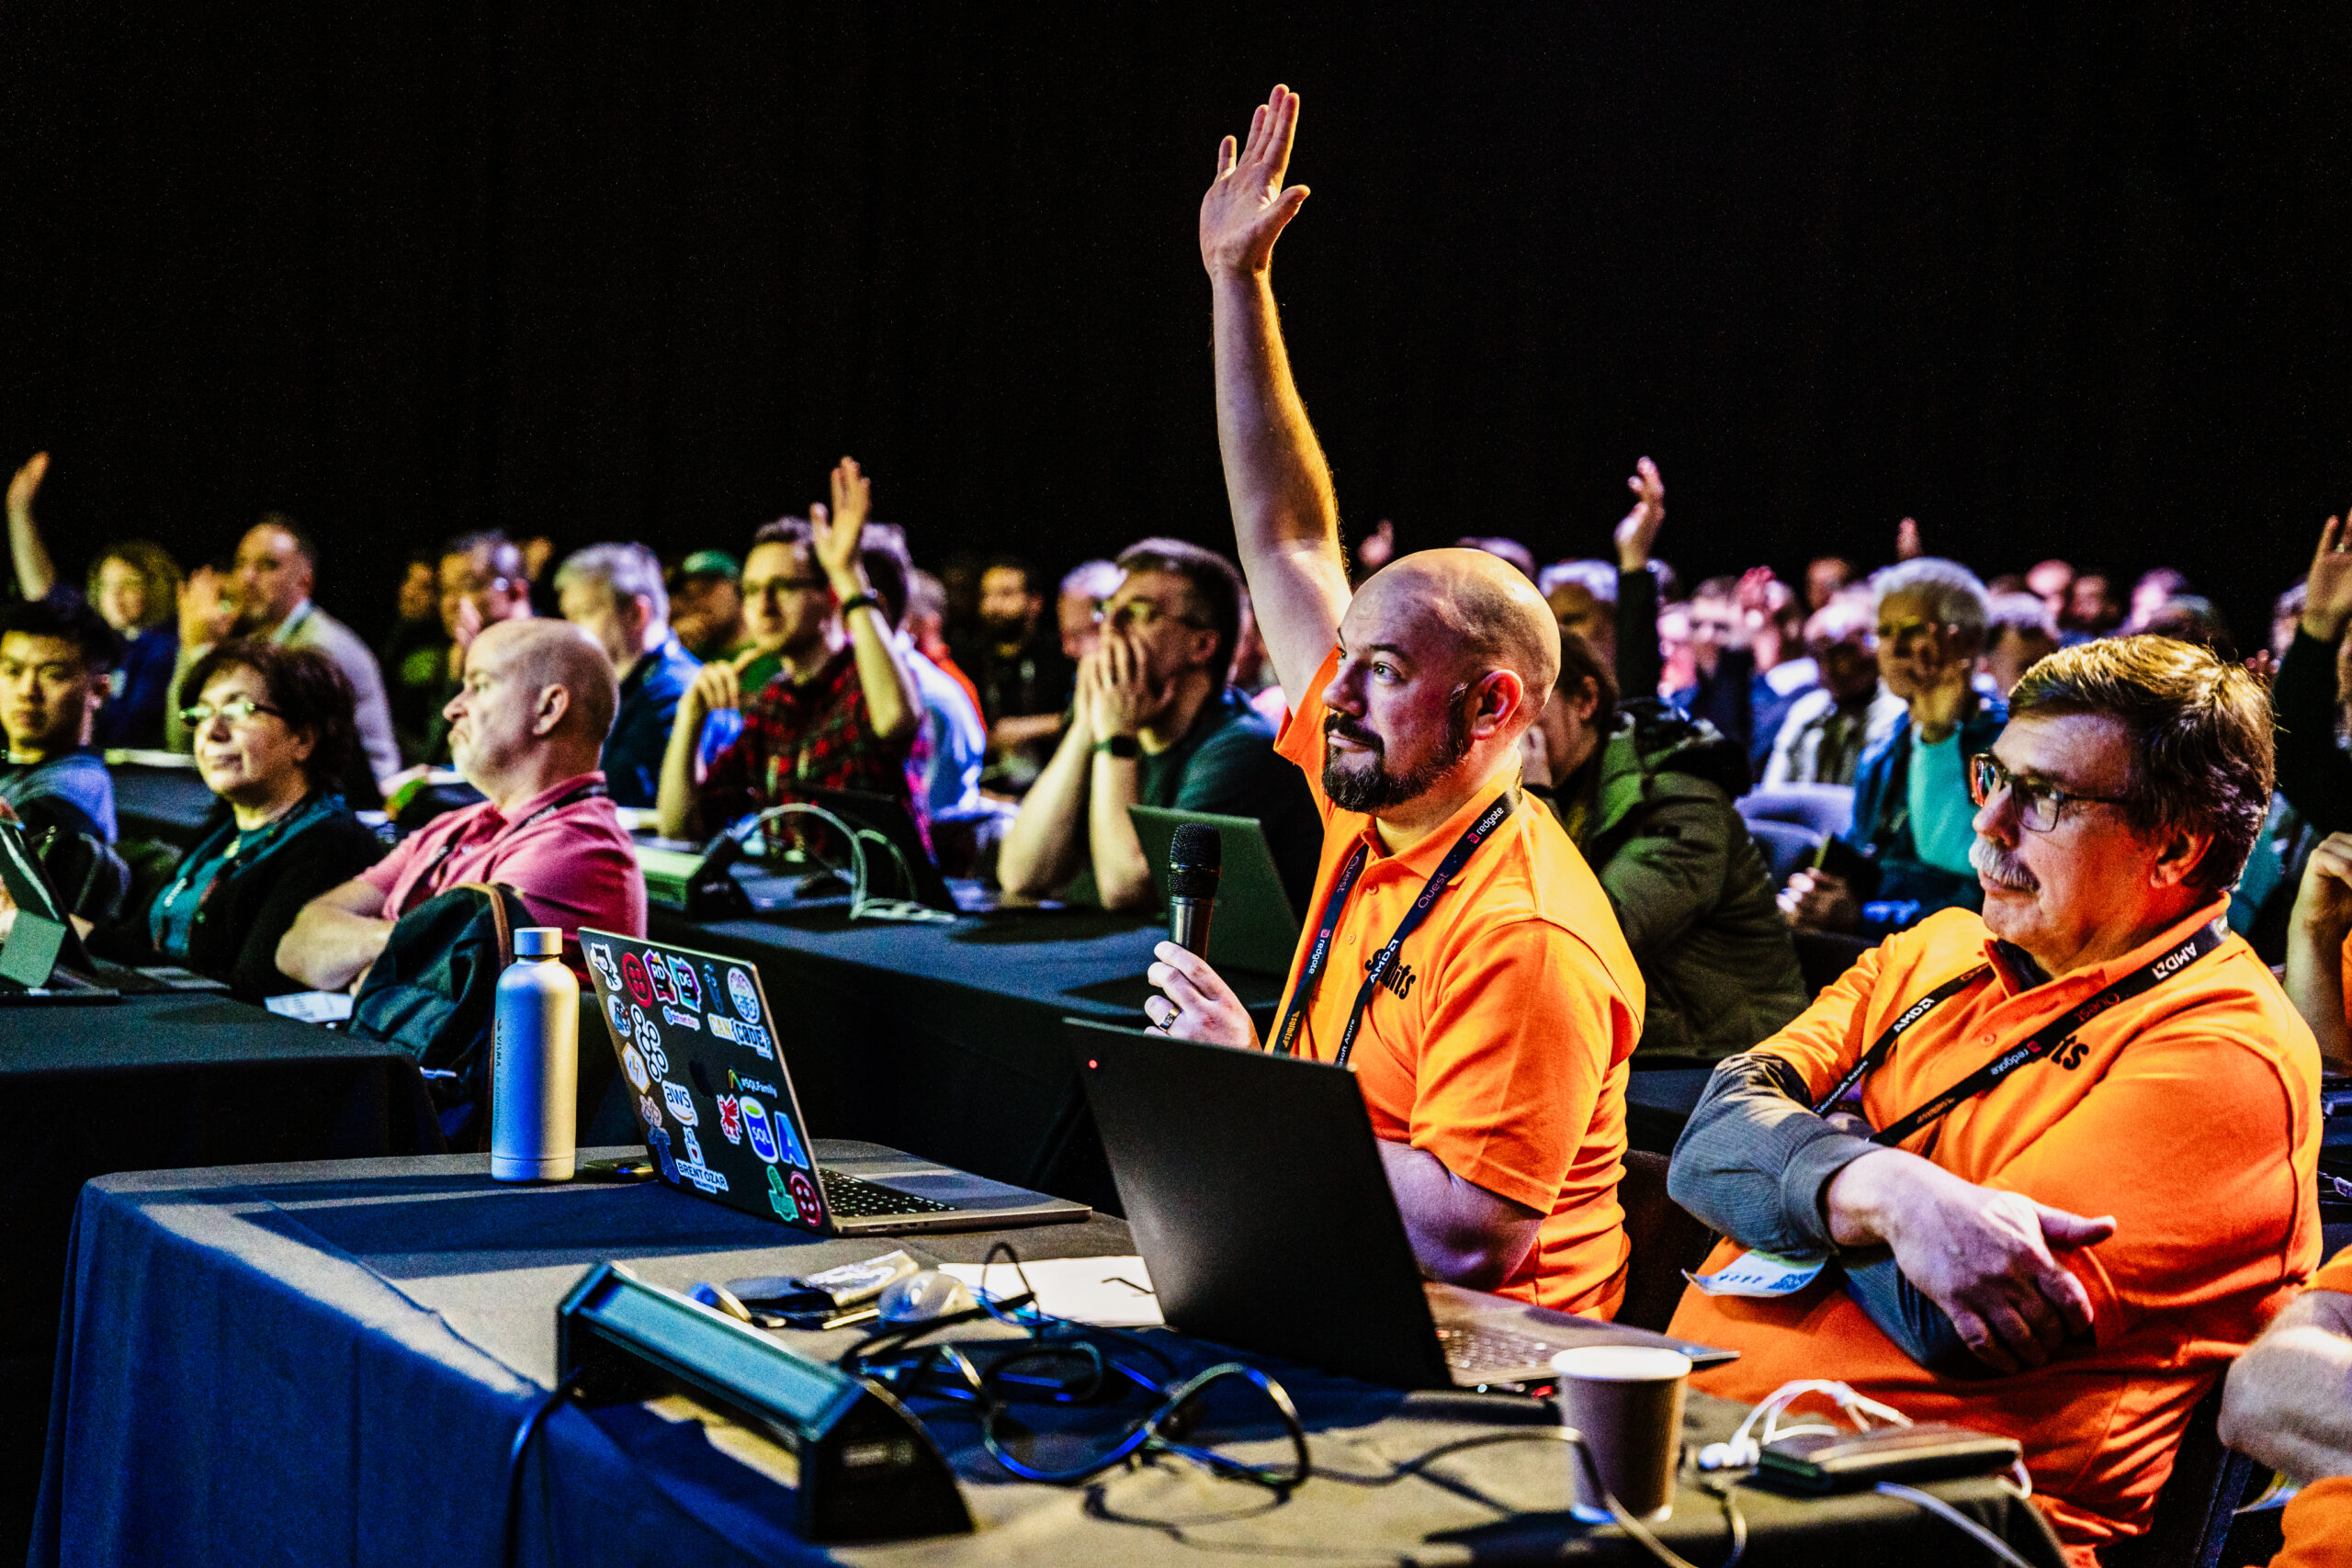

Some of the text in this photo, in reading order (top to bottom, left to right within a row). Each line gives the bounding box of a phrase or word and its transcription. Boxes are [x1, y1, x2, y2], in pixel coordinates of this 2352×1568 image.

[1476, 807, 1504, 836] redgate
[1337, 855, 1360, 893] Quest
[1418, 872, 1449, 908] Quest
[1308, 939, 1325, 975] redgate
[1370, 949, 1392, 984] AMD
[2165, 942, 2198, 971] AMD
[650, 964, 666, 980] RD
[677, 971, 694, 988] DG
[1893, 1004, 1925, 1033] AMD
[2073, 992, 2121, 1022] Quest
[1283, 1016, 1298, 1041] sqlbits
[1344, 1019, 1355, 1044] Azure
[1990, 1048, 2030, 1076] redgate
[664, 1086, 692, 1109] aws
[752, 1126, 772, 1145] SQL
[677, 1162, 727, 1189] BRENT OZAR
